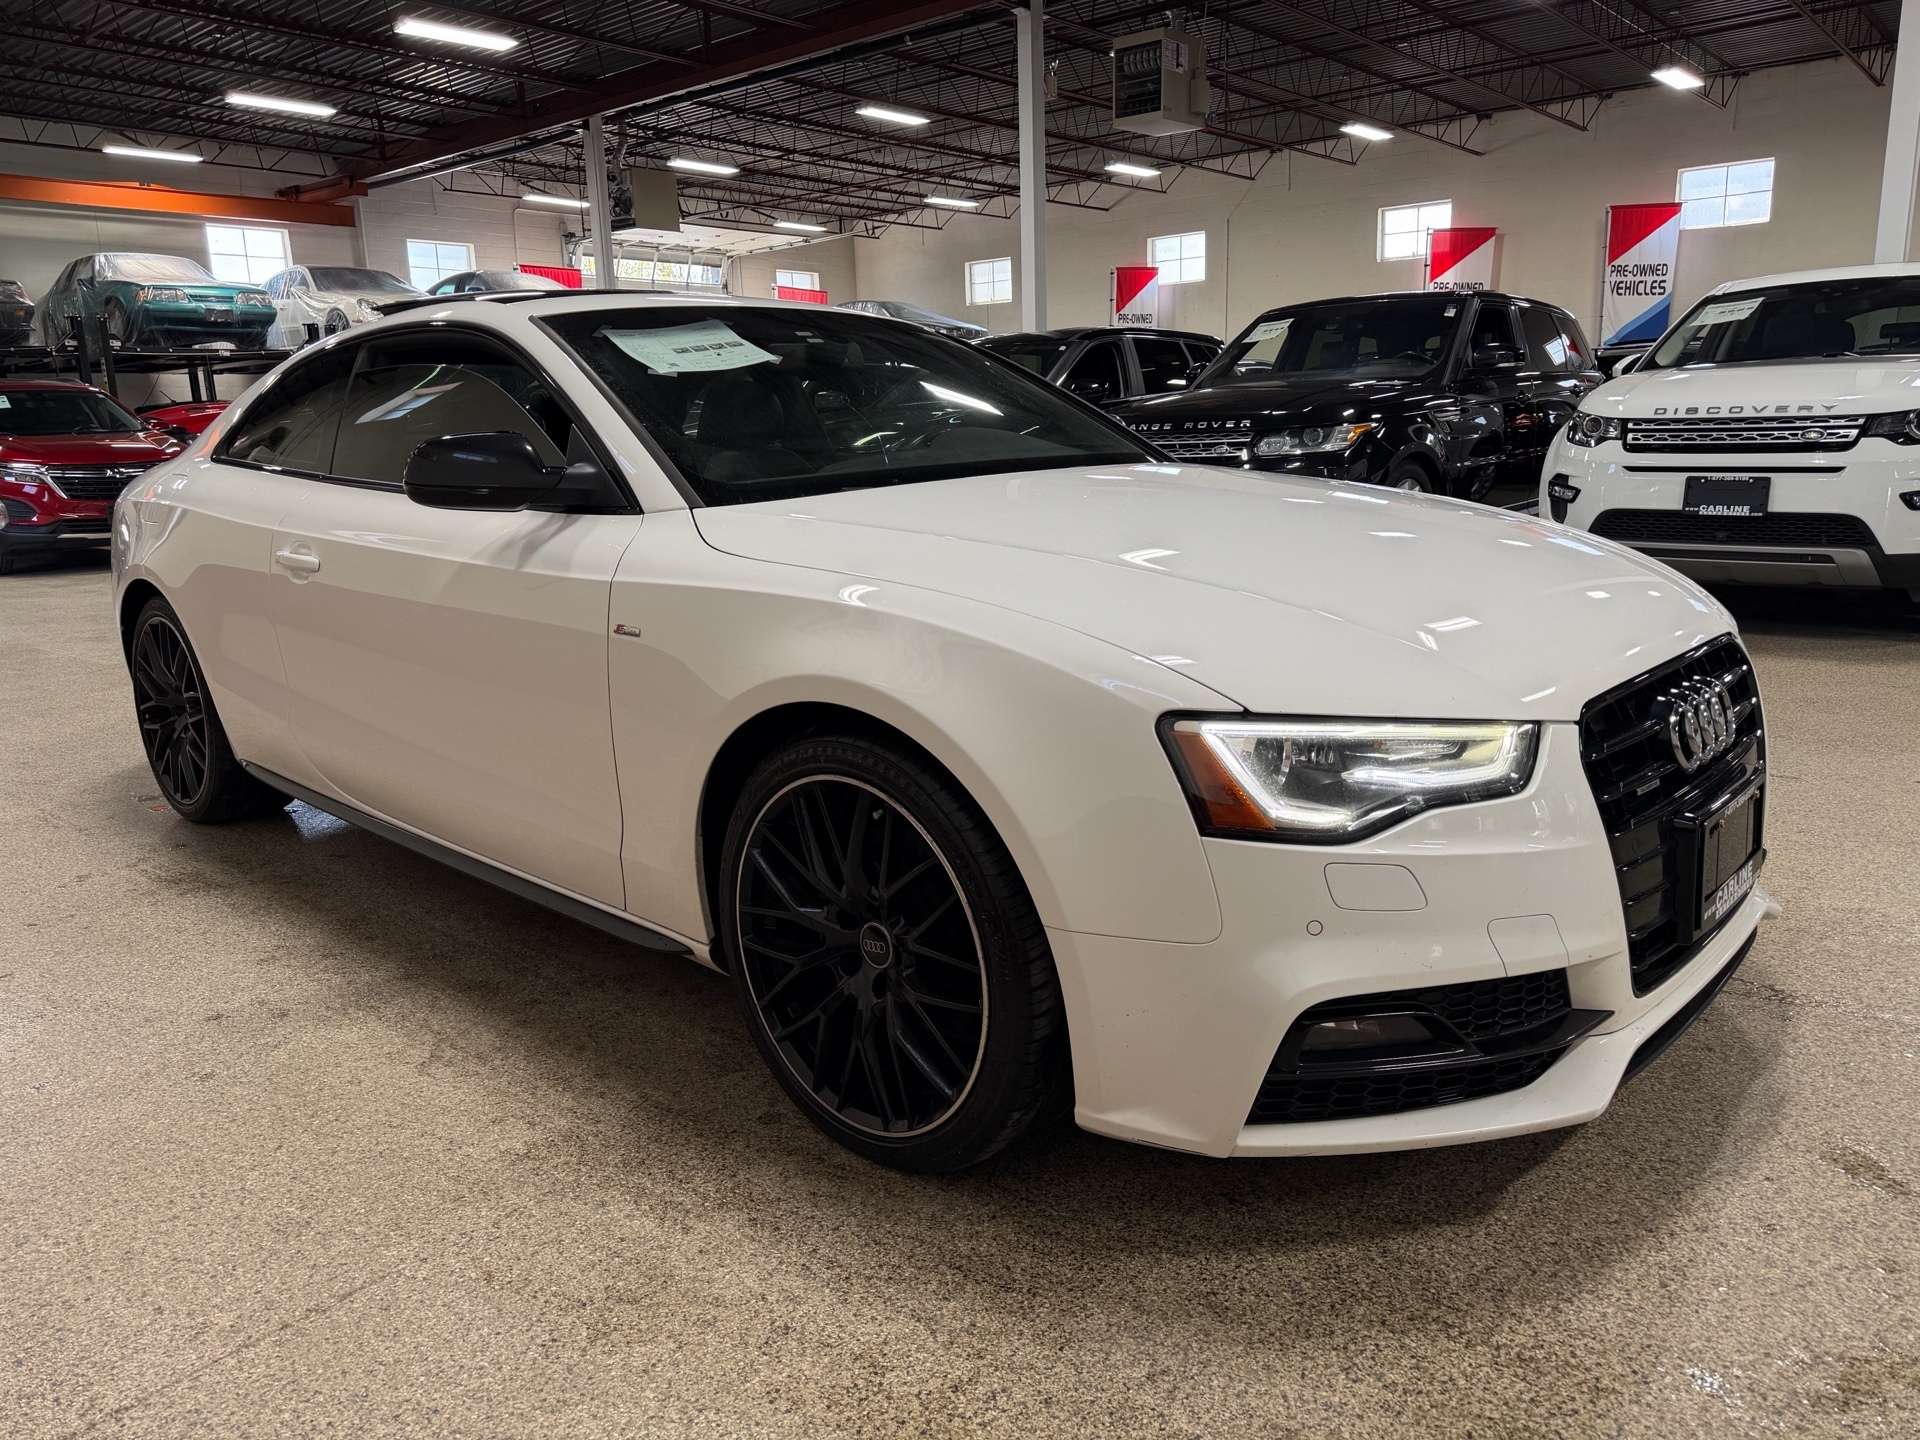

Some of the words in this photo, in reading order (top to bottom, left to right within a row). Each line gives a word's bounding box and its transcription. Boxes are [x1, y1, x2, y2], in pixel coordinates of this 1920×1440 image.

[1610, 263, 1669, 278] PRE-OWNED
[1433, 281, 1485, 291] PRE-OWNED
[1609, 280, 1667, 296] VEHICLES
[1117, 313, 1153, 324] PRE-OWNED
[1653, 404, 1839, 416] DISCOVERY
[1183, 420, 1252, 429] ROVER
[1716, 860, 1753, 907] CARLINE
